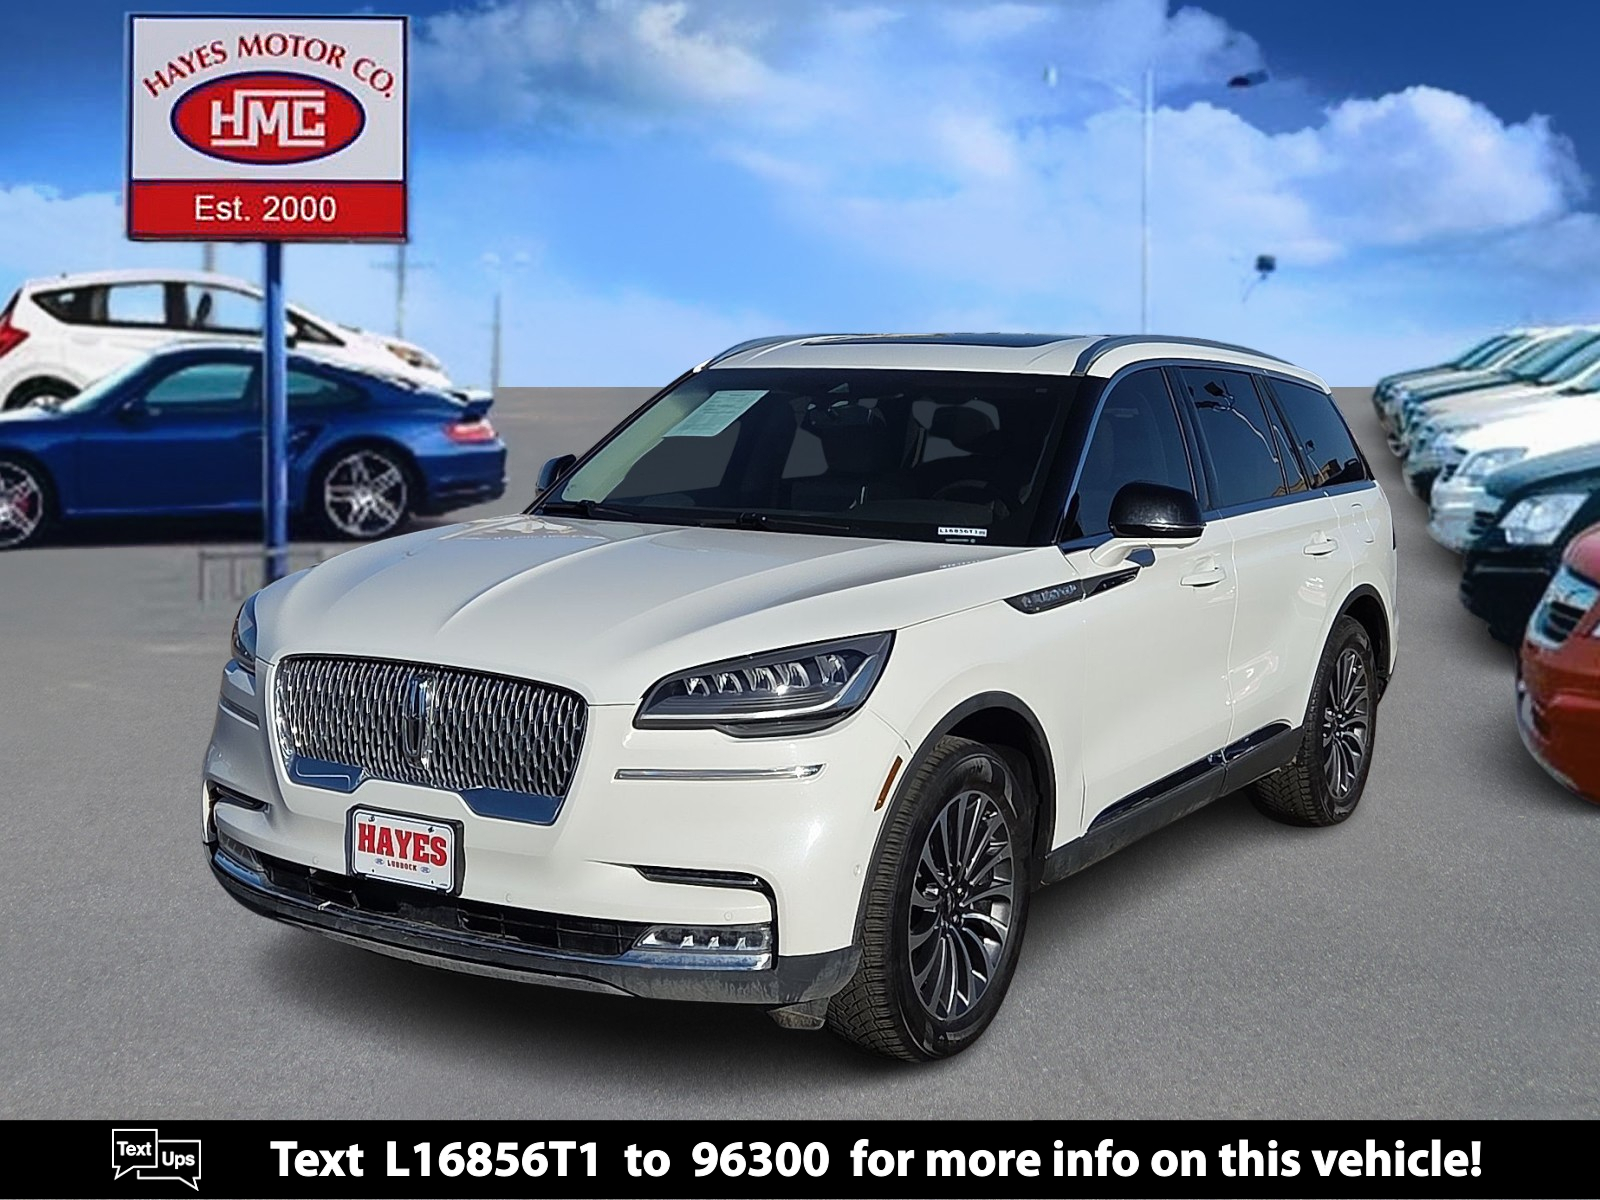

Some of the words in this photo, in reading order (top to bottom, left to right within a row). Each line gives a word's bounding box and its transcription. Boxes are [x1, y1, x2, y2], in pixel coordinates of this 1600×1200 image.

[142, 40, 228, 97] HAYES
[237, 32, 346, 69] MOTOR
[352, 57, 395, 98] CO.
[210, 88, 326, 147] HMC
[194, 194, 250, 221] Est.
[262, 195, 337, 222] 2000
[358, 823, 447, 866] HAYES
